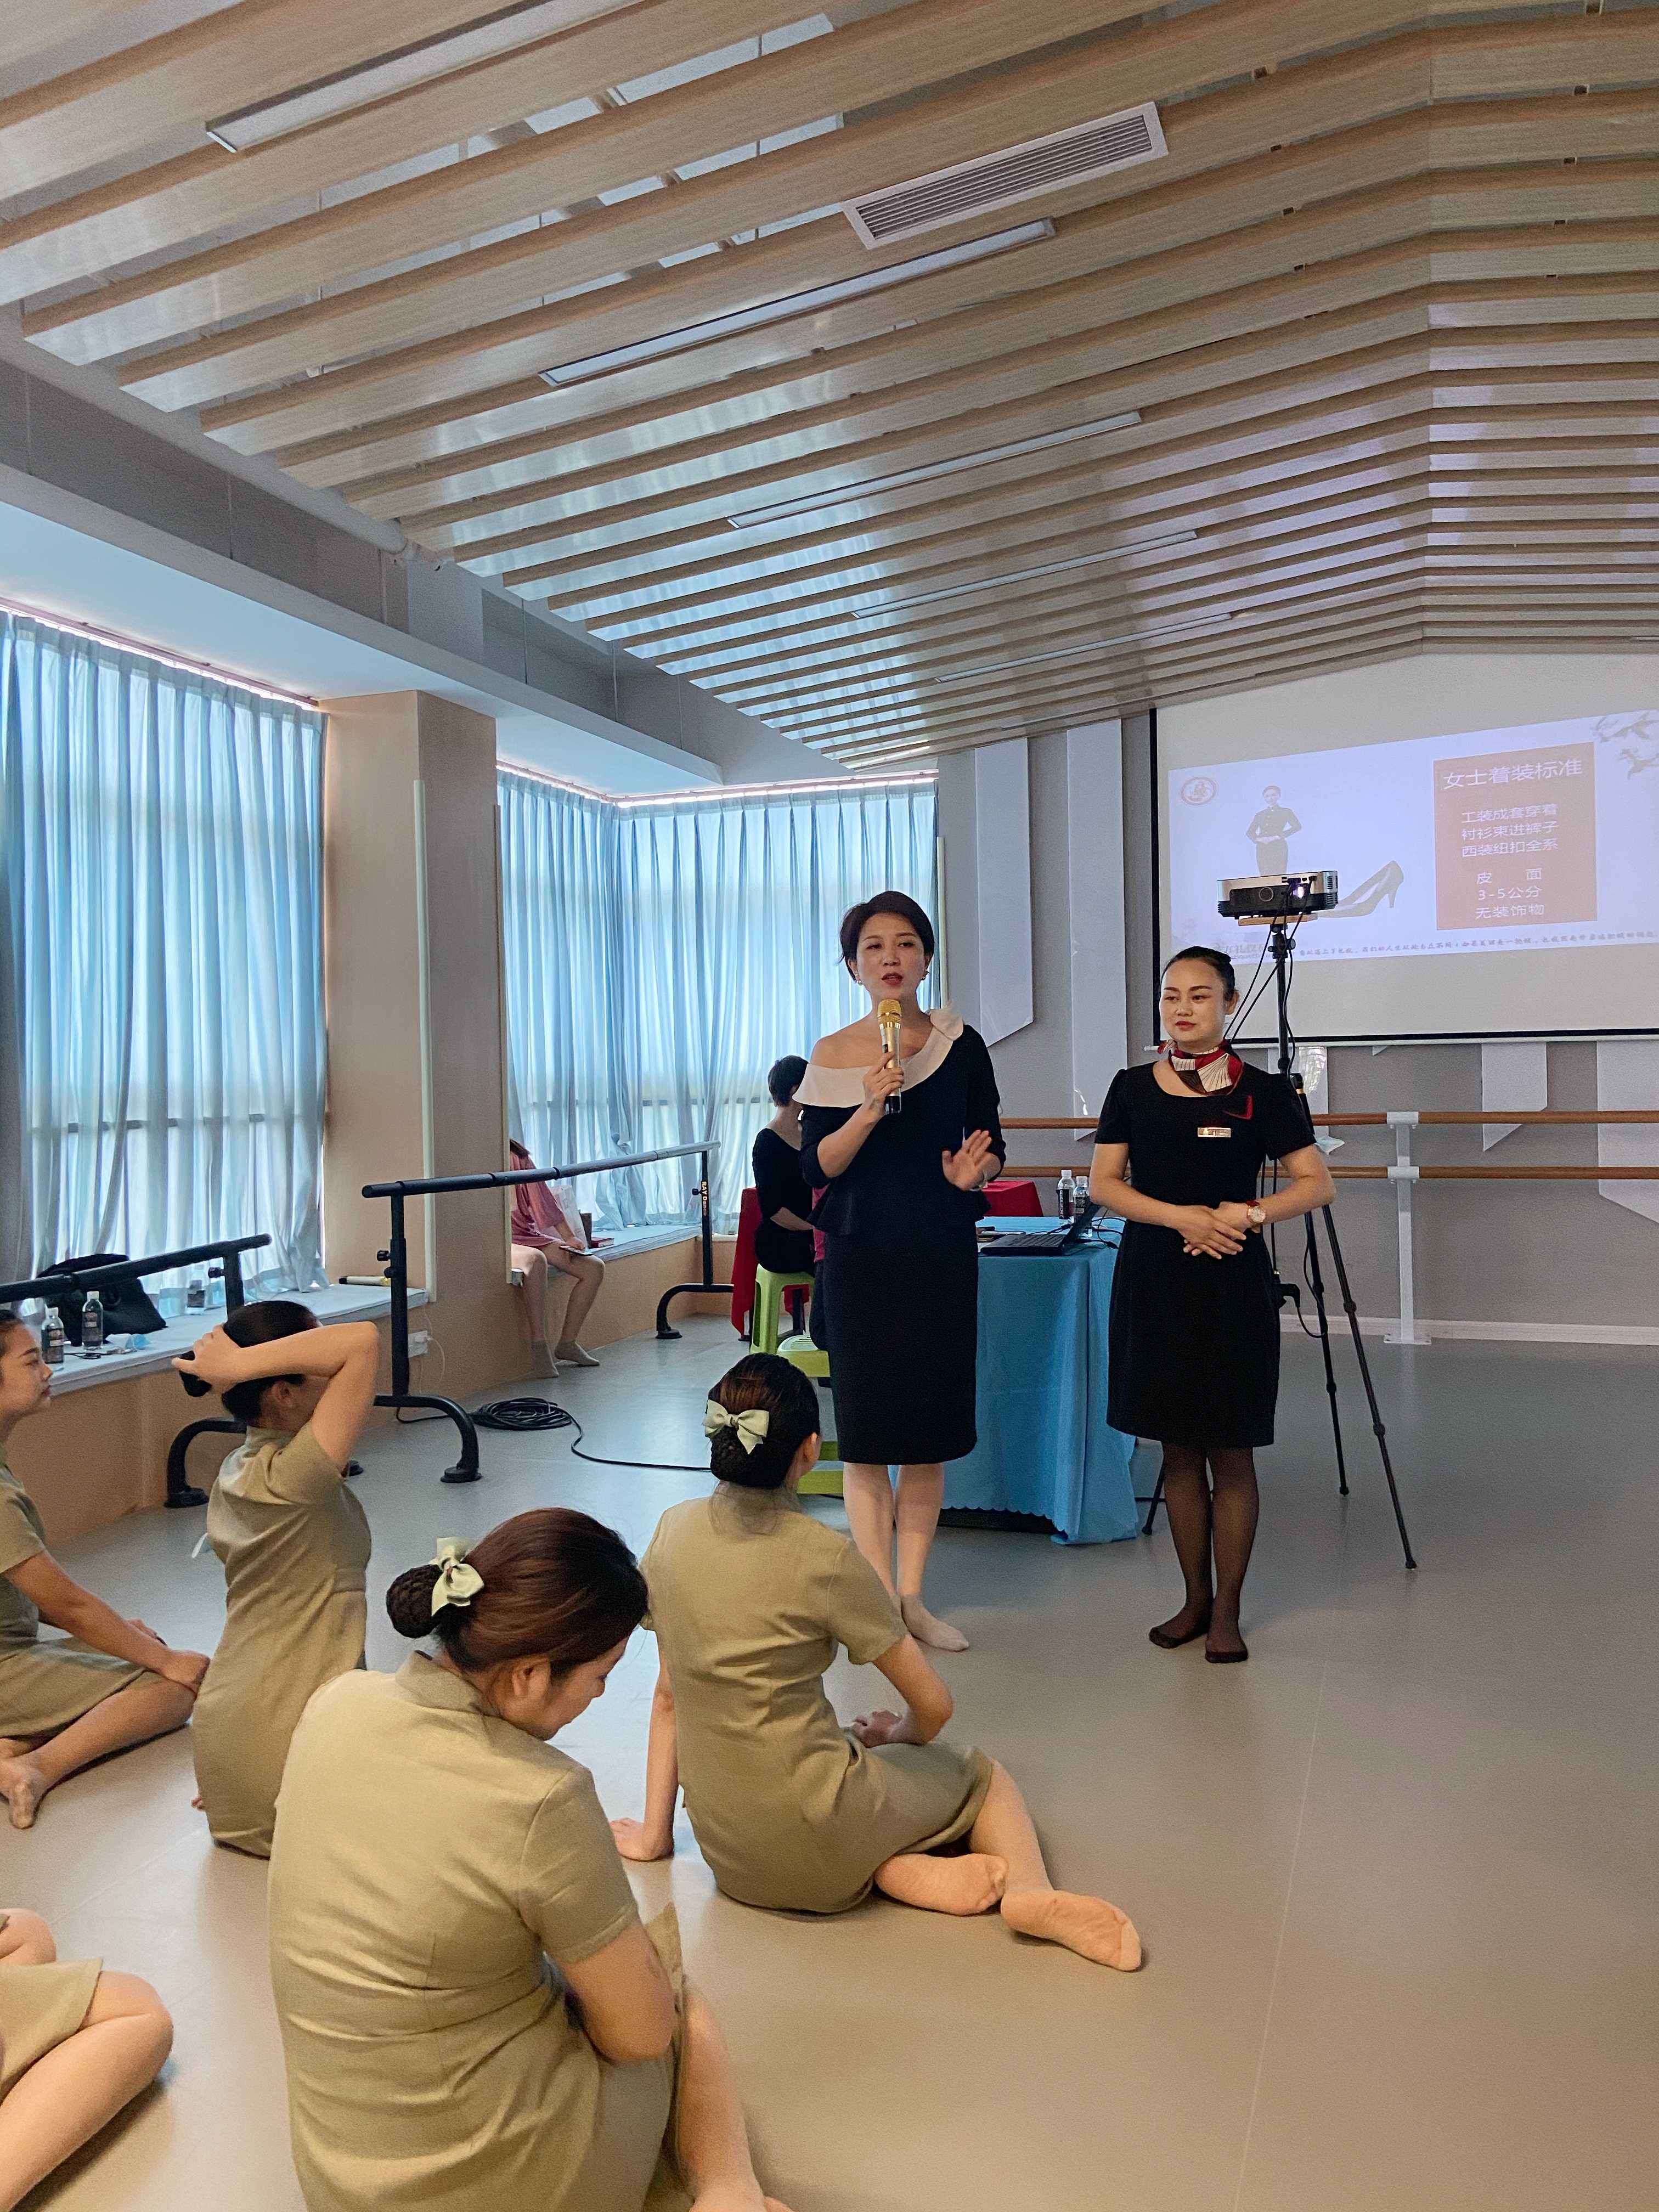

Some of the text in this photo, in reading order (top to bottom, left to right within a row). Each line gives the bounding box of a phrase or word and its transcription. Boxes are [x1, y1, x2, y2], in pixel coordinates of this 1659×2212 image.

[1443, 758, 1582, 790] 女士着装标准
[1461, 804, 1559, 823] 工装成套穿着
[1461, 821, 1559, 840] 衬衫束进裤子
[1462, 838, 1559, 857] 西装纽扣全系
[1478, 885, 1543, 900] 3-5公分
[1475, 905, 1545, 919] 无装饰物
